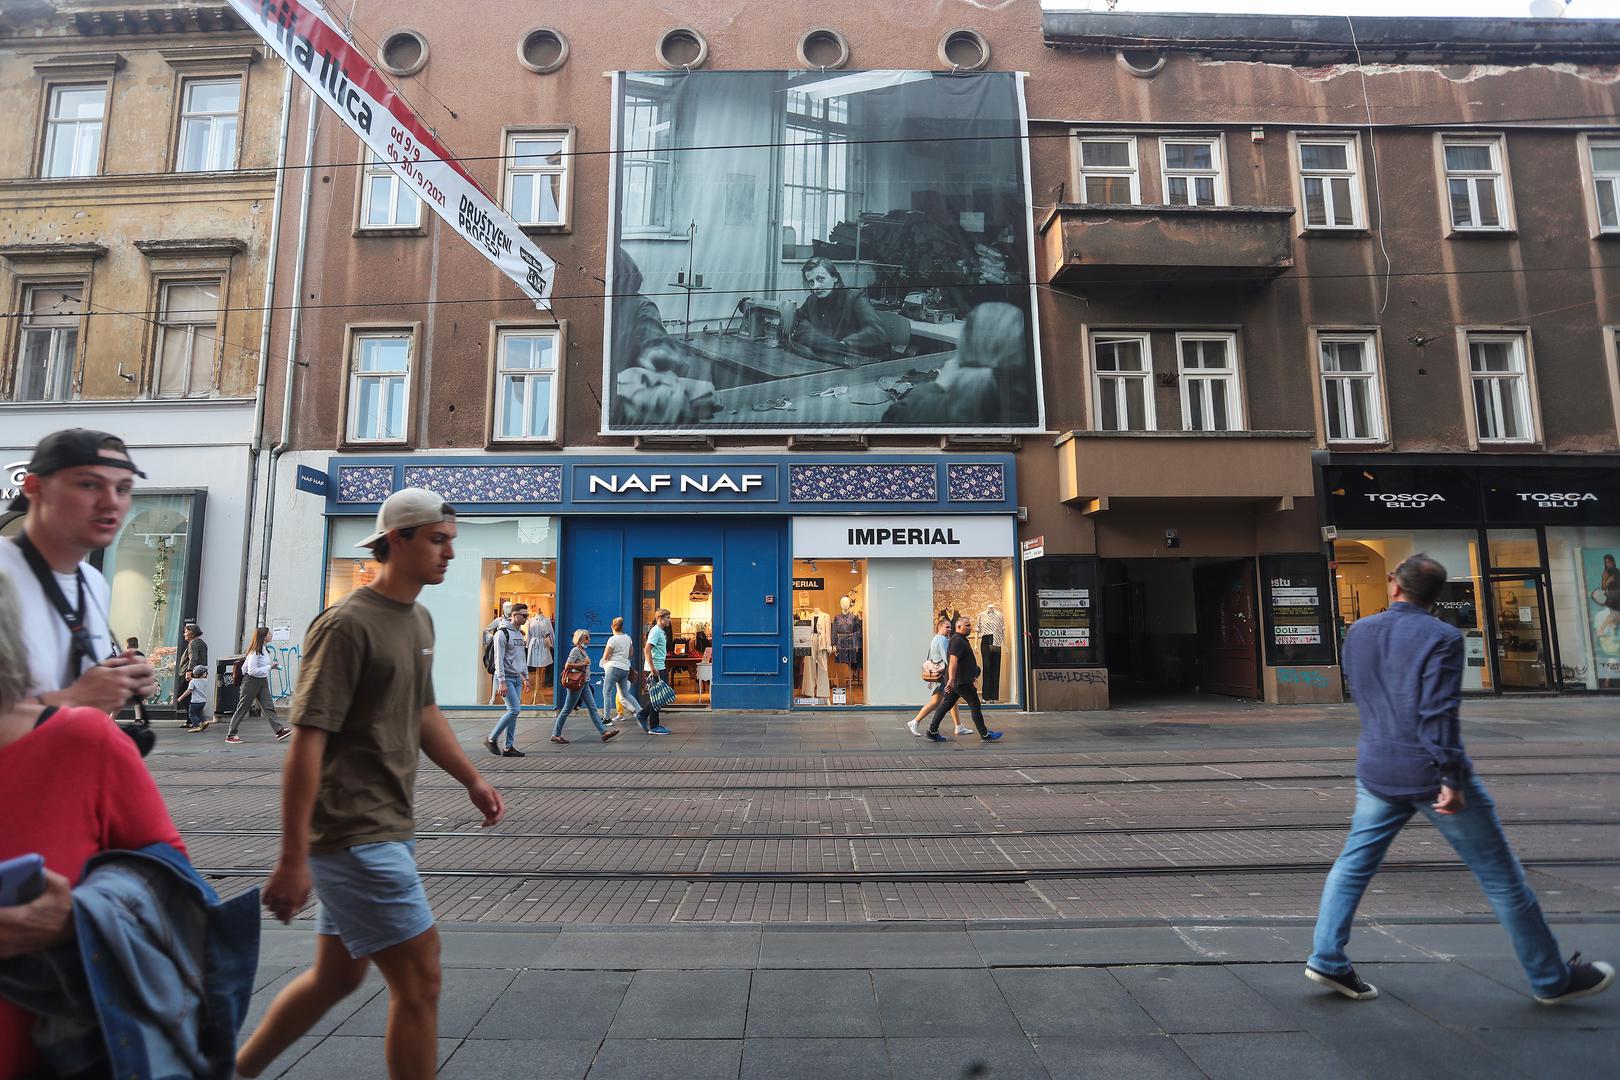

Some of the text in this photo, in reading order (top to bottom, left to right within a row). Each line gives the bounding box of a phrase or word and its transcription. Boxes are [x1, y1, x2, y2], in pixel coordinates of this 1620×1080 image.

[258, 0, 373, 136] rija Ilica
[390, 126, 420, 162] od 9/9
[387, 143, 446, 208] do 30/9/2021
[459, 194, 512, 254] DRUŠTVENI
[459, 211, 500, 259] PROCESI
[0, 488, 20, 499] KA
[589, 472, 762, 493] NAF NAF
[1516, 492, 1599, 501] TOSCA
[1364, 493, 1446, 502] TOSCA
[847, 528, 961, 545] IMPERIAL
